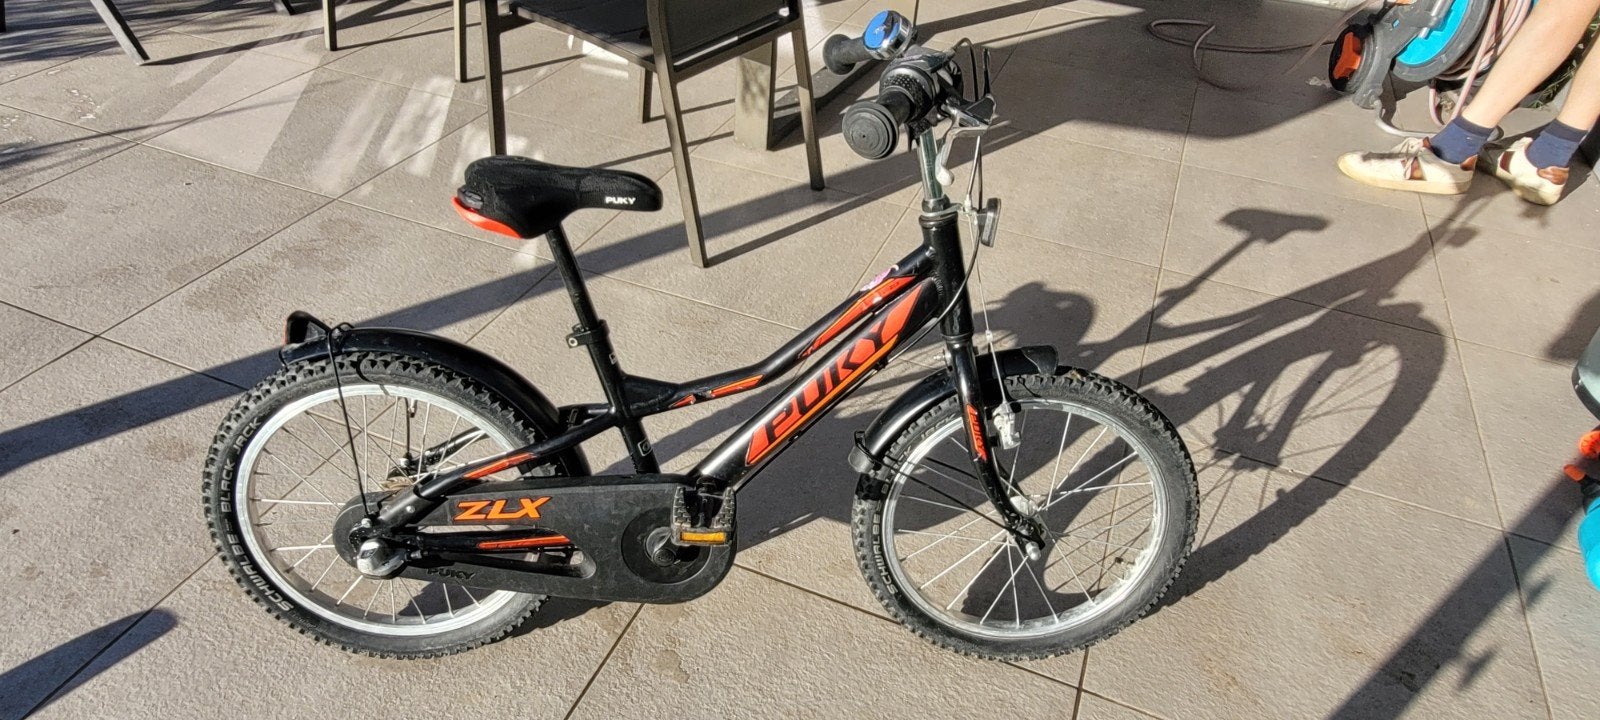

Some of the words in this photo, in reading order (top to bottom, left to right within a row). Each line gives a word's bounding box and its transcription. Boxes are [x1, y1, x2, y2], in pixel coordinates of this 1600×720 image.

[605, 196, 636, 205] PUKY
[758, 308, 898, 452] PUKY
[233, 417, 261, 454] JACK
[220, 458, 235, 512] BLACK
[872, 513, 898, 594] SCHWALBE
[921, 413, 957, 440] JACK
[453, 496, 552, 521] ZLX
[227, 533, 295, 612] SCHWALBE
[426, 567, 476, 581] PUKY
